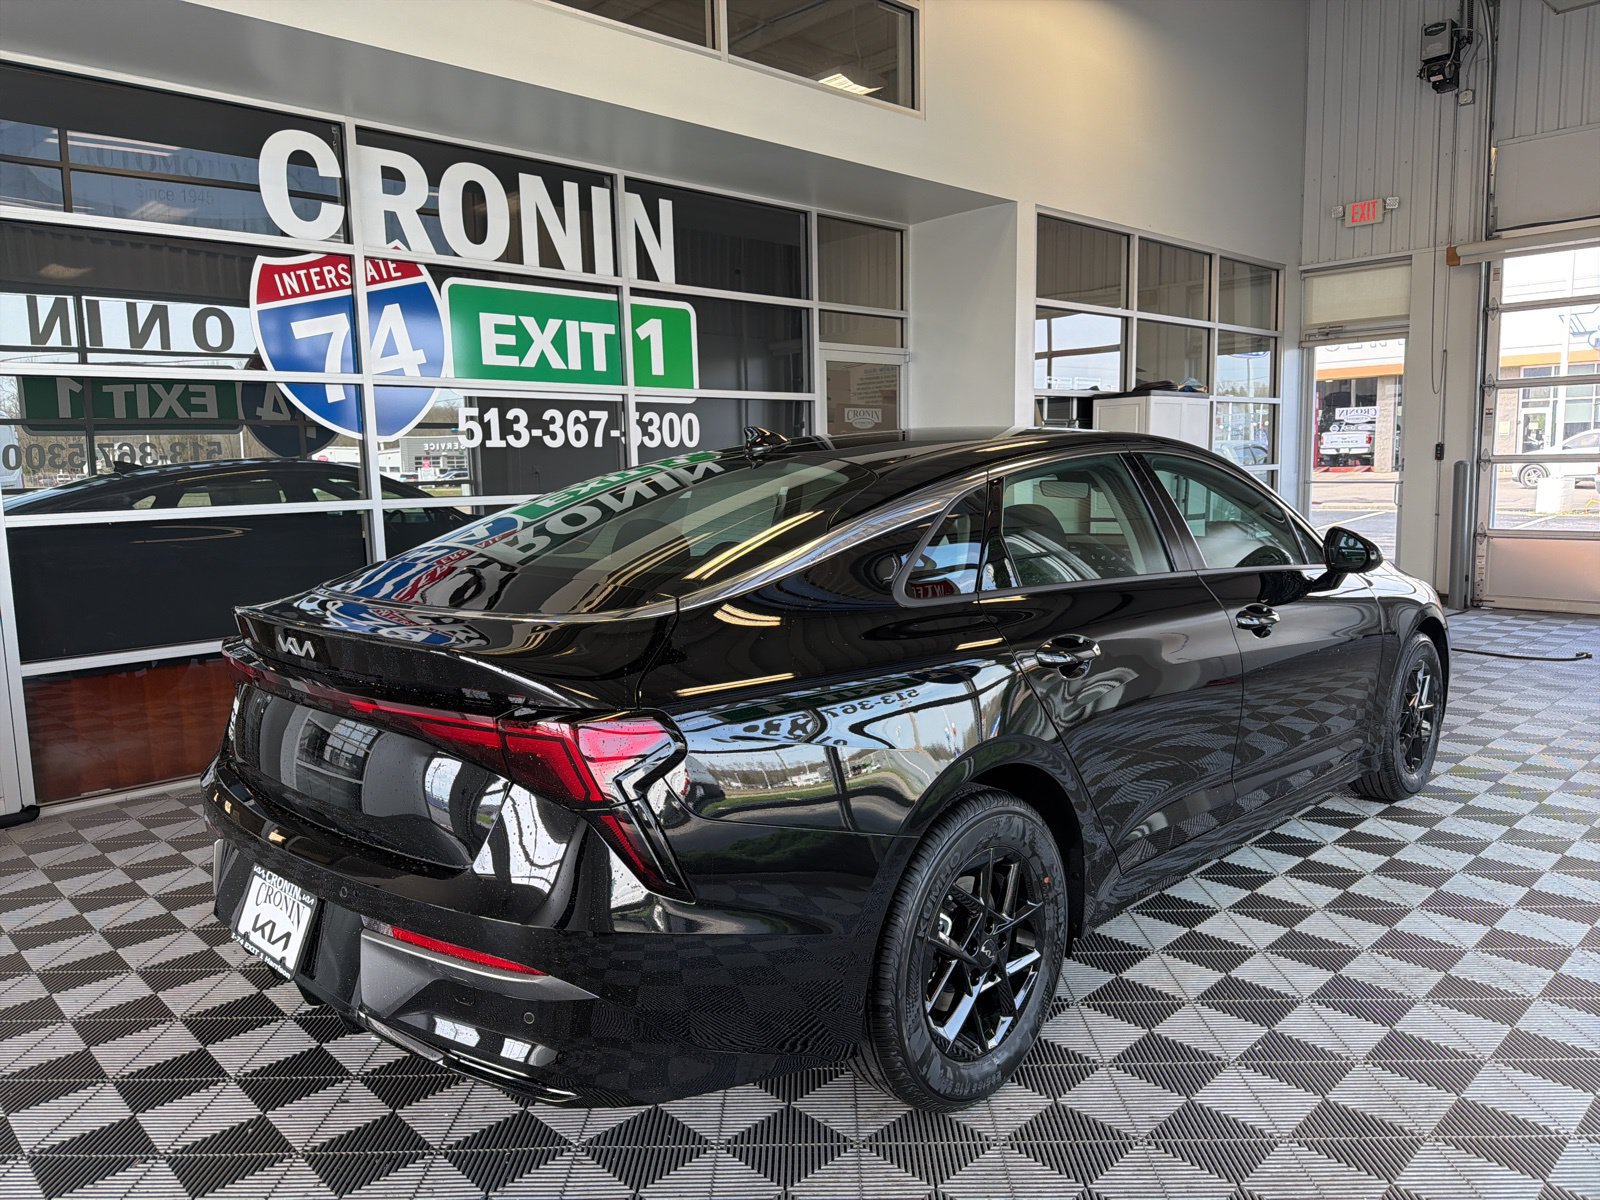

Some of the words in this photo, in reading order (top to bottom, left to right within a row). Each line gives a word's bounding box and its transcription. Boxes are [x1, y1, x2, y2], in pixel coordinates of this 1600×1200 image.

[258, 129, 676, 285] CRONIN
[1351, 200, 1377, 223] EXIT
[273, 259, 402, 297] INTERSATE
[291, 303, 427, 404] 74
[478, 312, 616, 372] EXIT
[635, 318, 665, 376] 1
[847, 408, 882, 422] CRONIN
[277, 633, 316, 659] KIA
[266, 871, 302, 901] CRONIN
[255, 882, 306, 931] CRONIN
[251, 913, 292, 952] KIA
[243, 942, 260, 956] EXIT
[264, 955, 291, 980] Harrison
